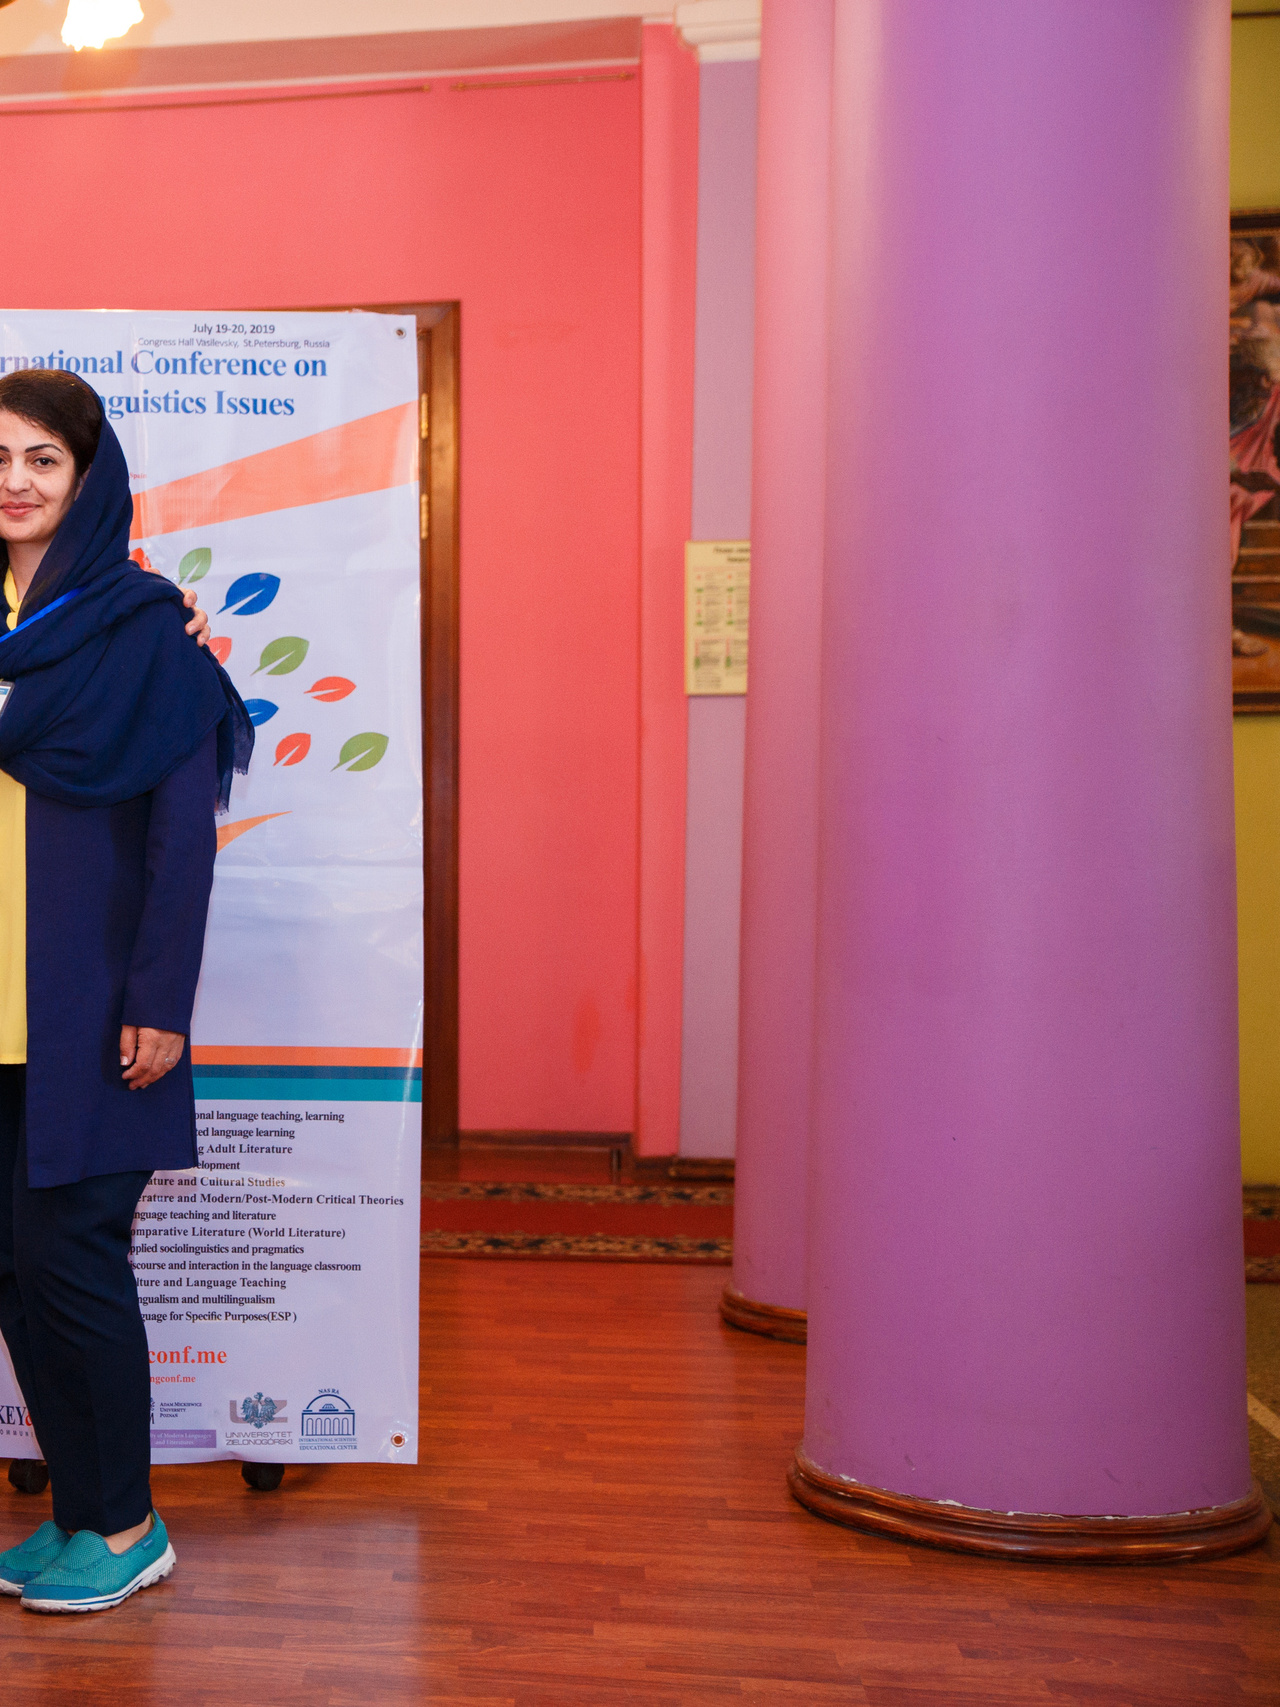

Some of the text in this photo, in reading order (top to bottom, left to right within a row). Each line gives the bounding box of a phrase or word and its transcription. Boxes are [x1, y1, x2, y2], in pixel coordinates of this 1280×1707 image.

[192, 323, 276, 336] July 19-20, 2019
[137, 338, 177, 348] Congress
[178, 338, 194, 347] Hall
[304, 340, 330, 348] Russia
[131, 350, 287, 376] Conference
[294, 358, 328, 377] on
[214, 390, 295, 416] Issues
[216, 1110, 259, 1122] language
[261, 1110, 303, 1123] teaching,
[305, 1112, 345, 1124] learning
[211, 1127, 254, 1139] language
[256, 1128, 296, 1140] learning
[206, 1144, 236, 1155] Adult
[239, 1144, 293, 1155] Literature
[177, 1176, 197, 1186] and
[200, 1177, 245, 1187] Cultural
[247, 1177, 286, 1188] Studies
[177, 1193, 197, 1203] and
[200, 1193, 314, 1205] Modern/Post-Modern
[316, 1194, 356, 1205] Critical
[358, 1195, 404, 1206] Theories
[170, 1210, 210, 1222] teaching
[211, 1210, 230, 1220] and
[232, 1210, 277, 1221] literature
[192, 1227, 246, 1238] Literature
[248, 1227, 285, 1239] (World
[288, 1227, 346, 1239] Literature)
[159, 1243, 230, 1256] sociolinguistics
[231, 1244, 250, 1254] and
[251, 1244, 305, 1257] pragmatics
[168, 1261, 187, 1270] and
[188, 1260, 240, 1271] interaction
[241, 1261, 251, 1271] in
[253, 1261, 268, 1271] the
[270, 1261, 313, 1272] language
[314, 1261, 362, 1272] classroom
[163, 1278, 183, 1287] and
[186, 1278, 238, 1289] Language
[240, 1278, 287, 1290] Teaching
[181, 1295, 200, 1305] and
[202, 1295, 276, 1307] multilingualism
[169, 1311, 184, 1321] for
[185, 1311, 222, 1323] Specific
[225, 1431, 293, 1439] UNIWERSYTET
